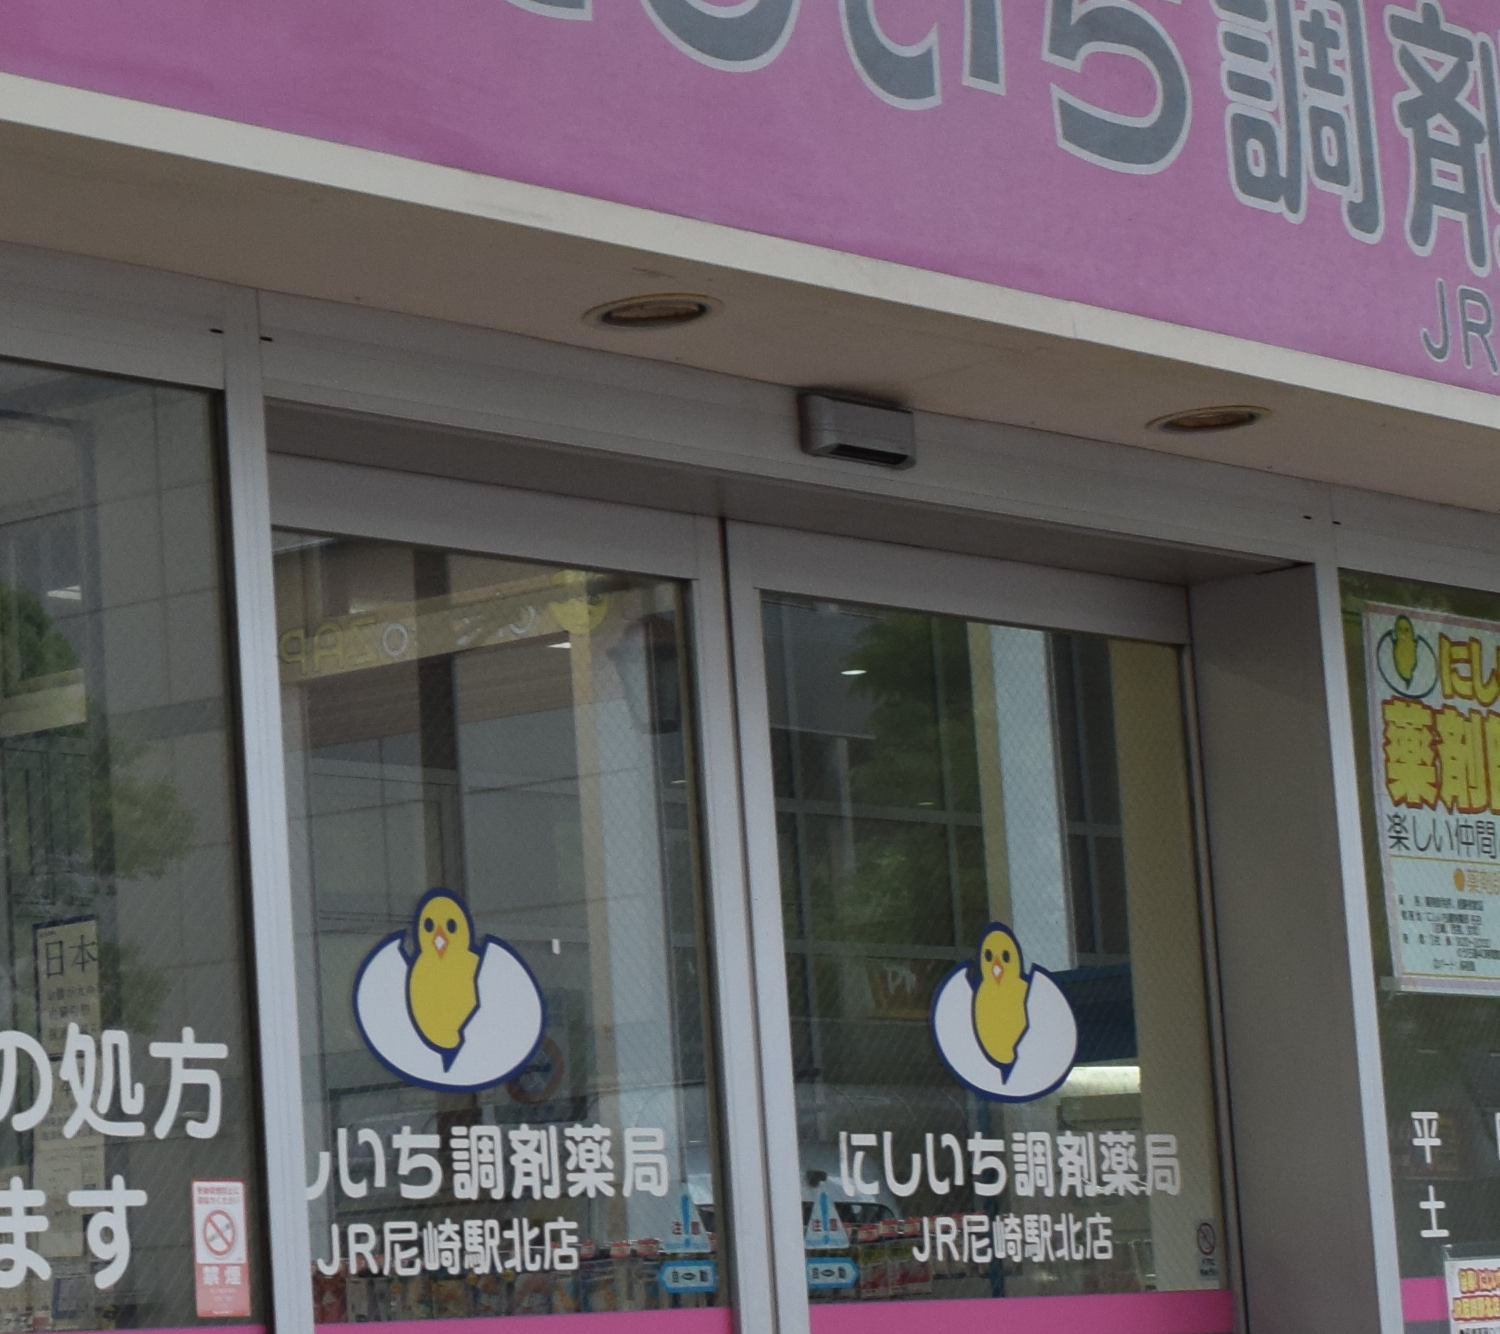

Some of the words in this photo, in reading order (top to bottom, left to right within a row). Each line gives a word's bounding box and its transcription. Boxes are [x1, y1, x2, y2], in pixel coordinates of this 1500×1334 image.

[839, 1129, 1181, 1200] にしいち調剤薬局
[911, 1213, 1114, 1264] JR尼崎駅北店
[1419, 1185, 1450, 1238] 土
[316, 1218, 580, 1276] JR尼崎駅北店
